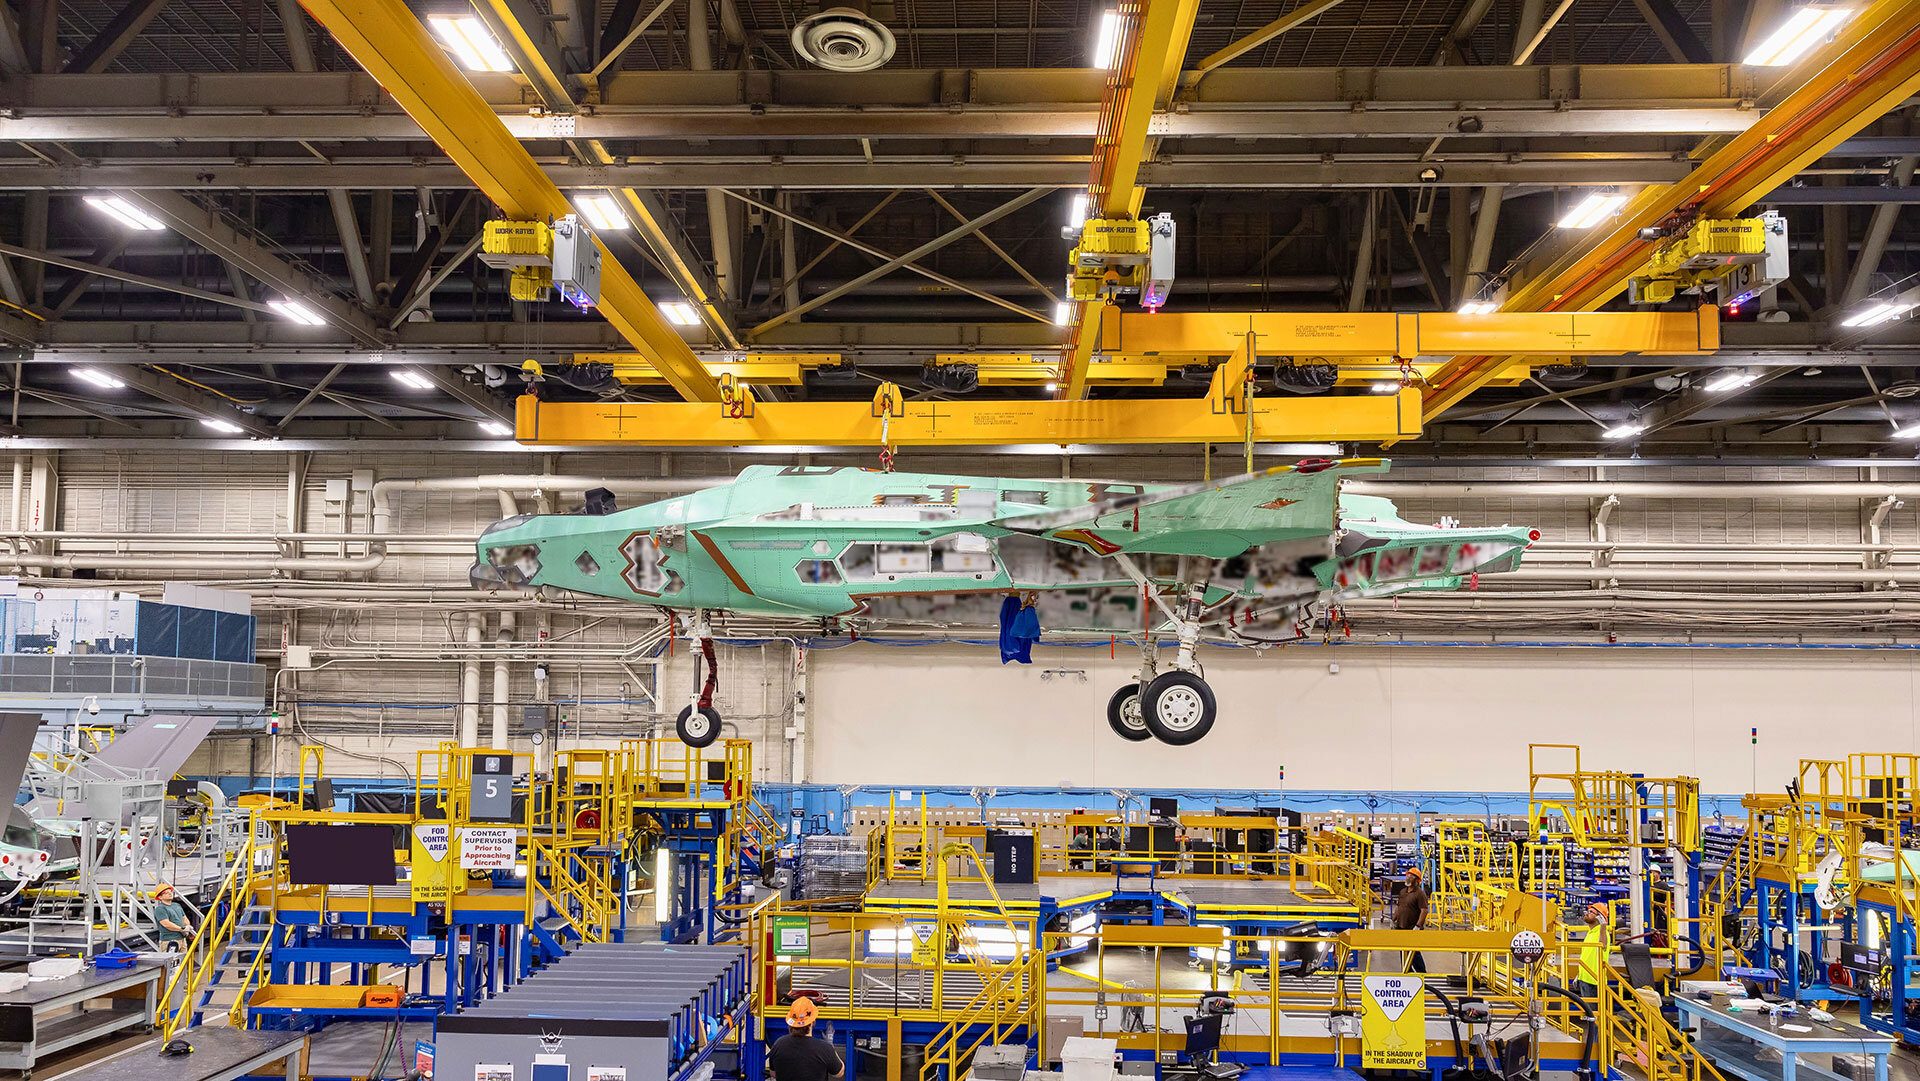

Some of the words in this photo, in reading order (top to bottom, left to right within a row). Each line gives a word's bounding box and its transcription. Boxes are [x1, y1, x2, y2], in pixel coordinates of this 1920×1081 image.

[485, 779, 497, 798] 5
[1011, 863, 1016, 873] NO
[1513, 939, 1540, 947] CLEAN
[1385, 979, 1401, 987] FOD
[1374, 989, 1412, 998] CONTROL
[1382, 999, 1404, 1007] AREA
